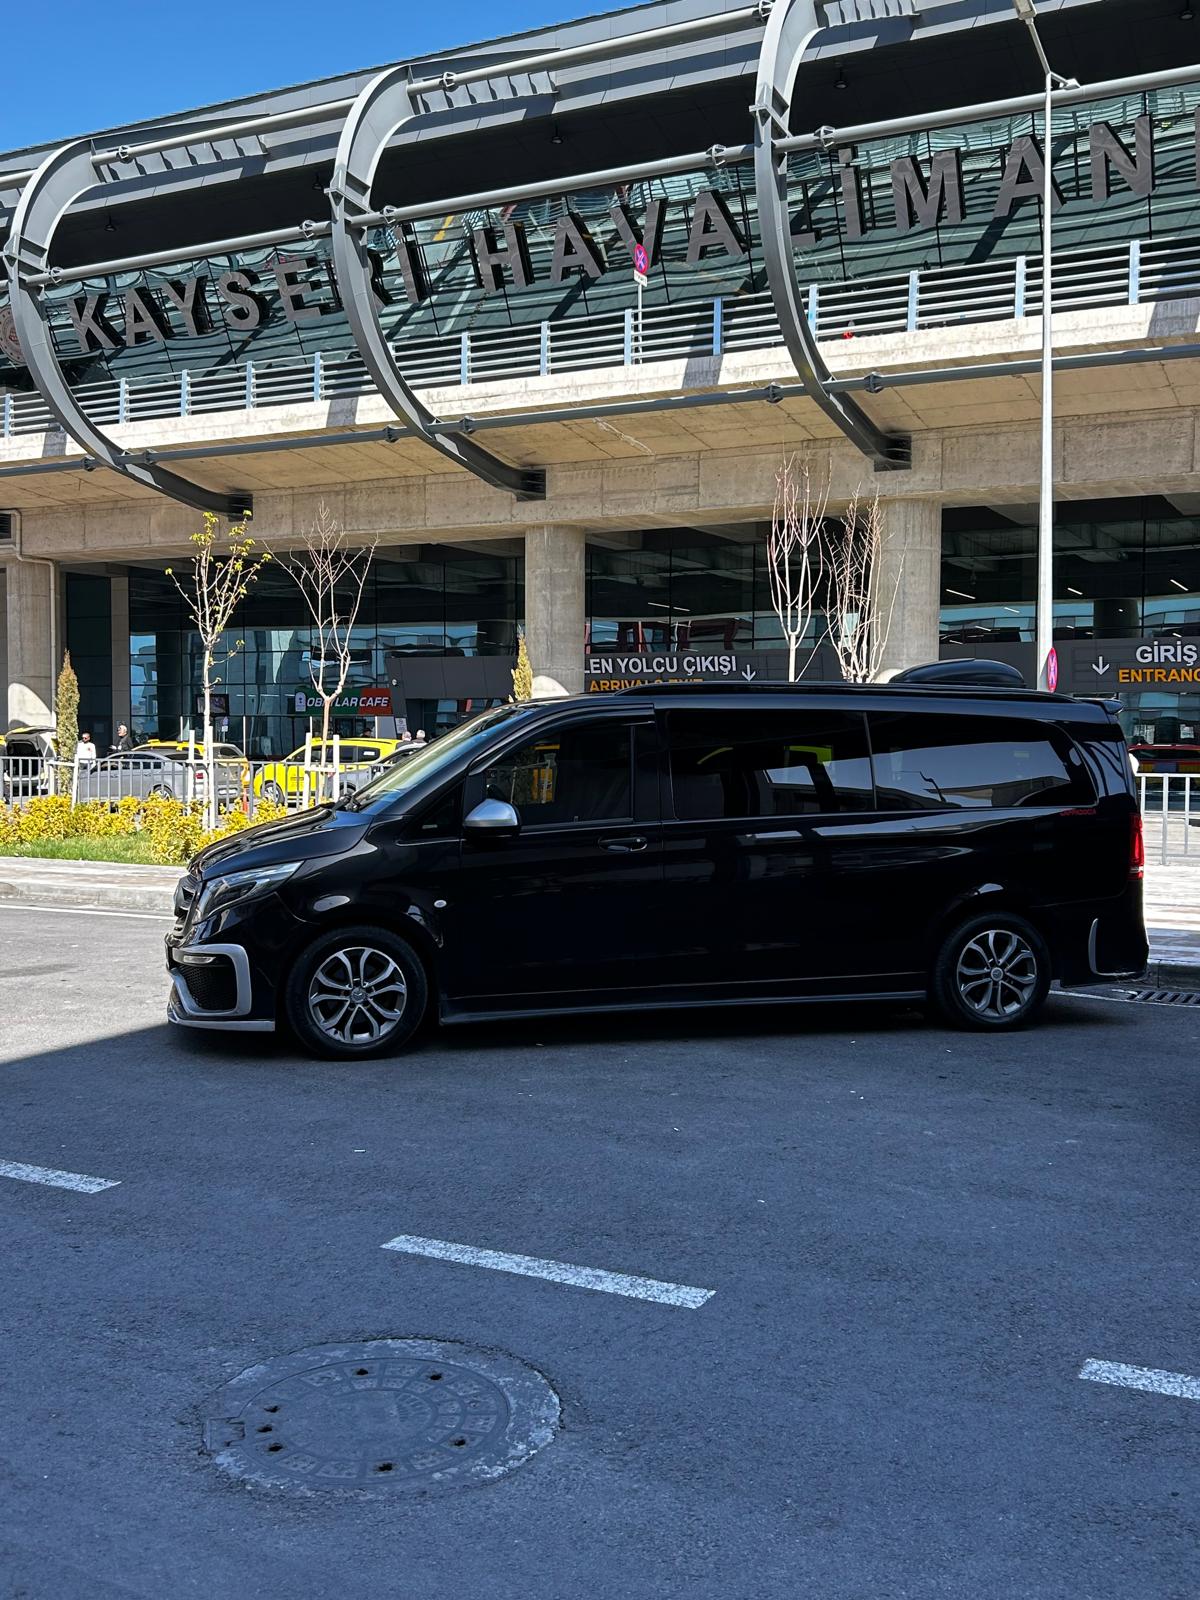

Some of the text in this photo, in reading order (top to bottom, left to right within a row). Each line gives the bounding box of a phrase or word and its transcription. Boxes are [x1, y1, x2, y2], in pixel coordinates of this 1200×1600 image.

[66, 223, 420, 352] KAYSEİ
[1136, 640, 1198, 667] GİRİŞ
[584, 655, 737, 676] EN YOLCU ÇIKIŞI
[589, 680, 661, 692] ARRIVA
[307, 697, 389, 707] OBLAR CAFE
